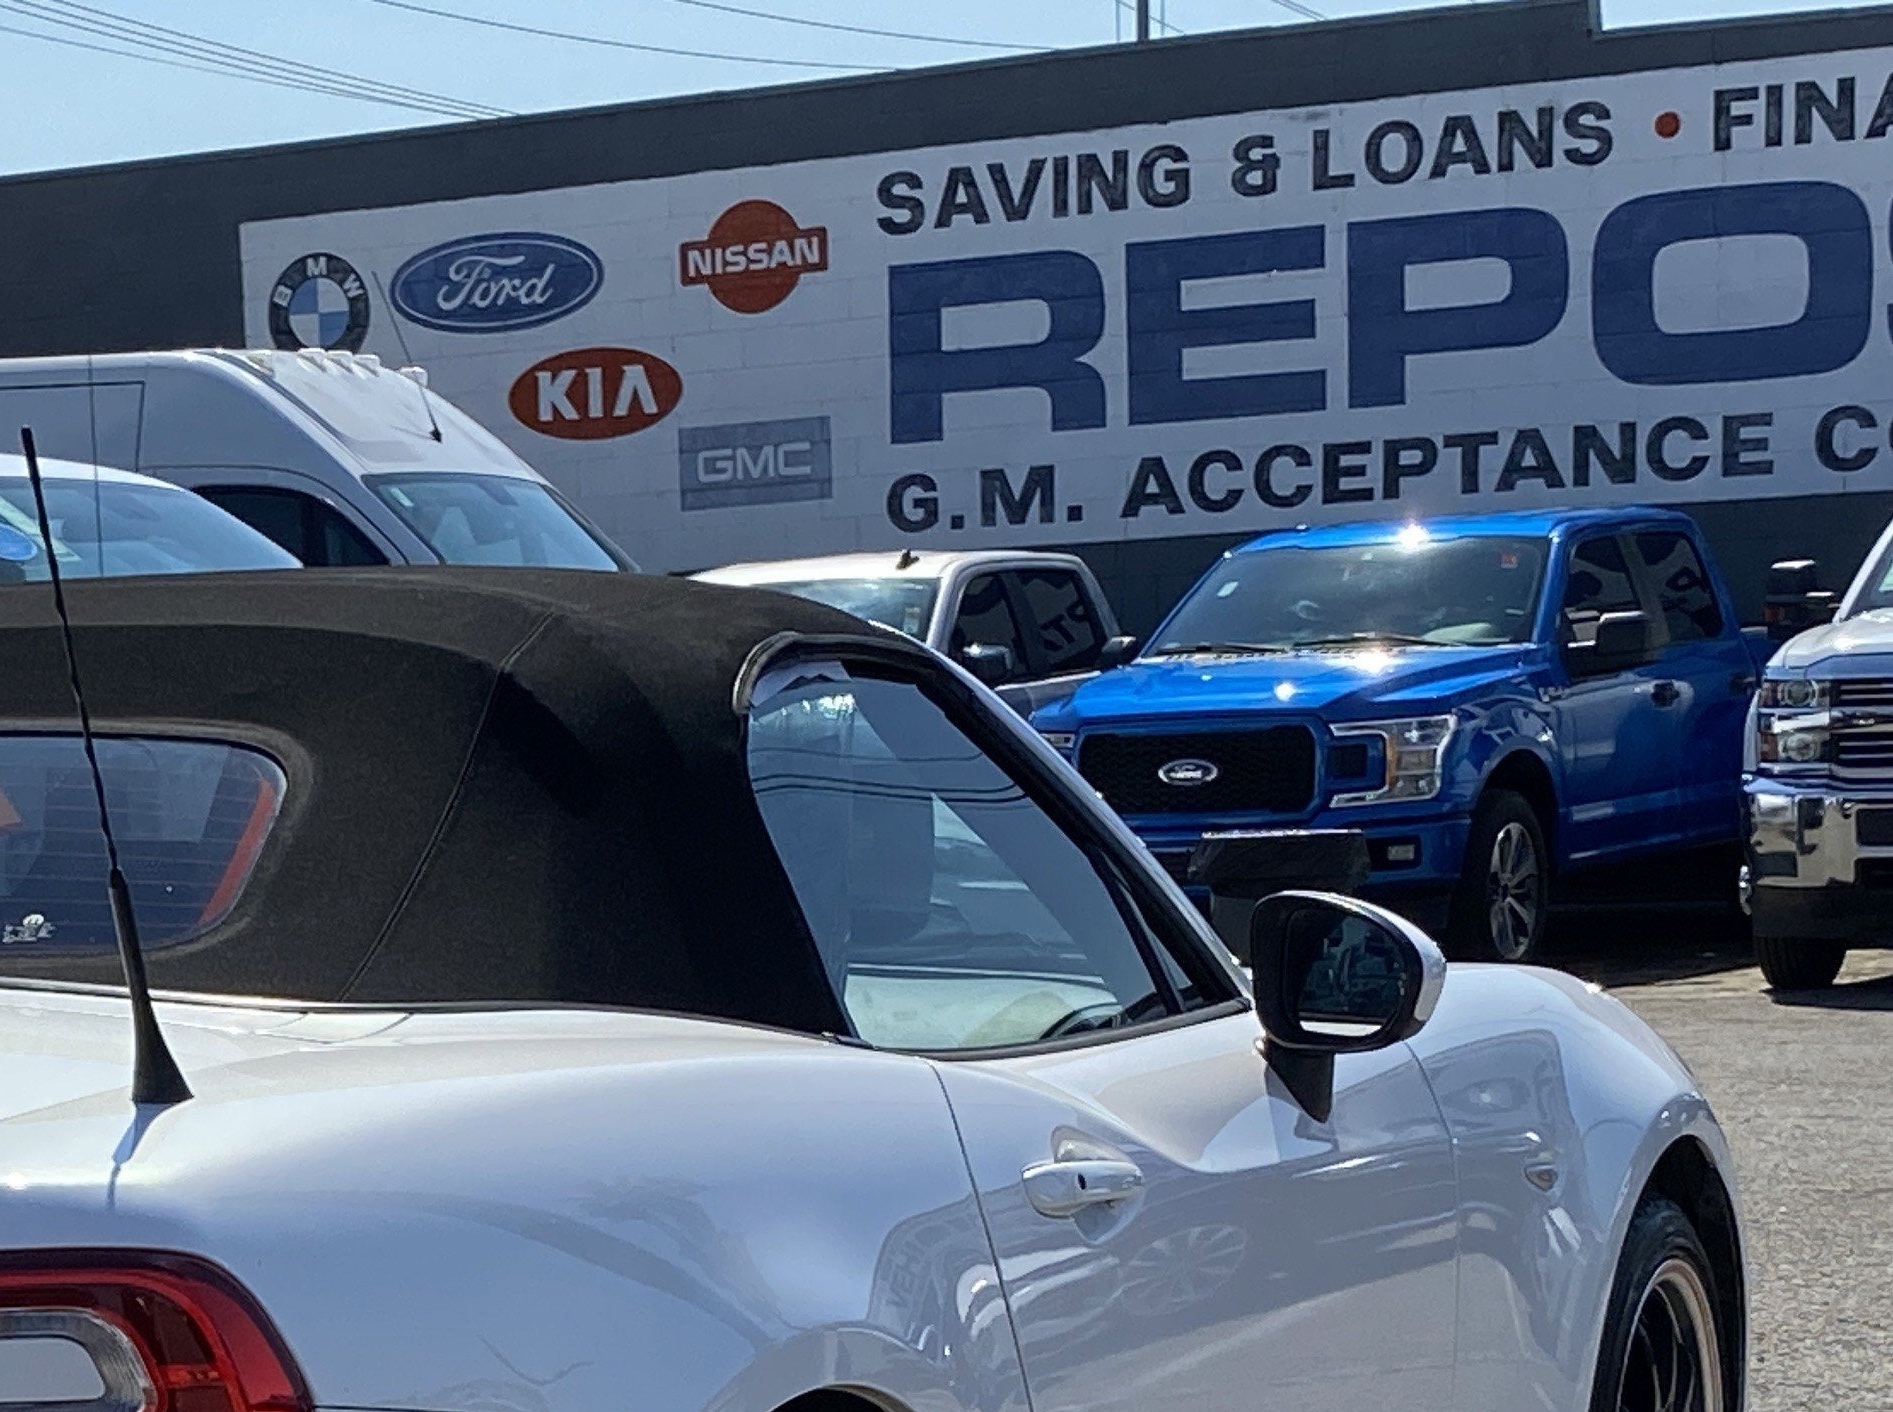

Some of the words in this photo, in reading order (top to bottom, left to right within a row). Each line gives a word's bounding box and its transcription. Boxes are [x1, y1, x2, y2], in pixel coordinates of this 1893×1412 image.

[875, 142, 1191, 236] SAVING
[1231, 134, 1280, 197] &
[1312, 100, 1613, 191] LOANS
[272, 256, 365, 308] BMW
[437, 254, 554, 312] Ford
[687, 236, 820, 277] NISSAN
[888, 179, 1893, 445] REPO
[535, 364, 658, 425] KIA
[696, 442, 811, 484] GMC
[887, 464, 1084, 534] G.M.
[1119, 411, 1775, 519] ACCEPTANCE
[1814, 405, 1893, 473] C
